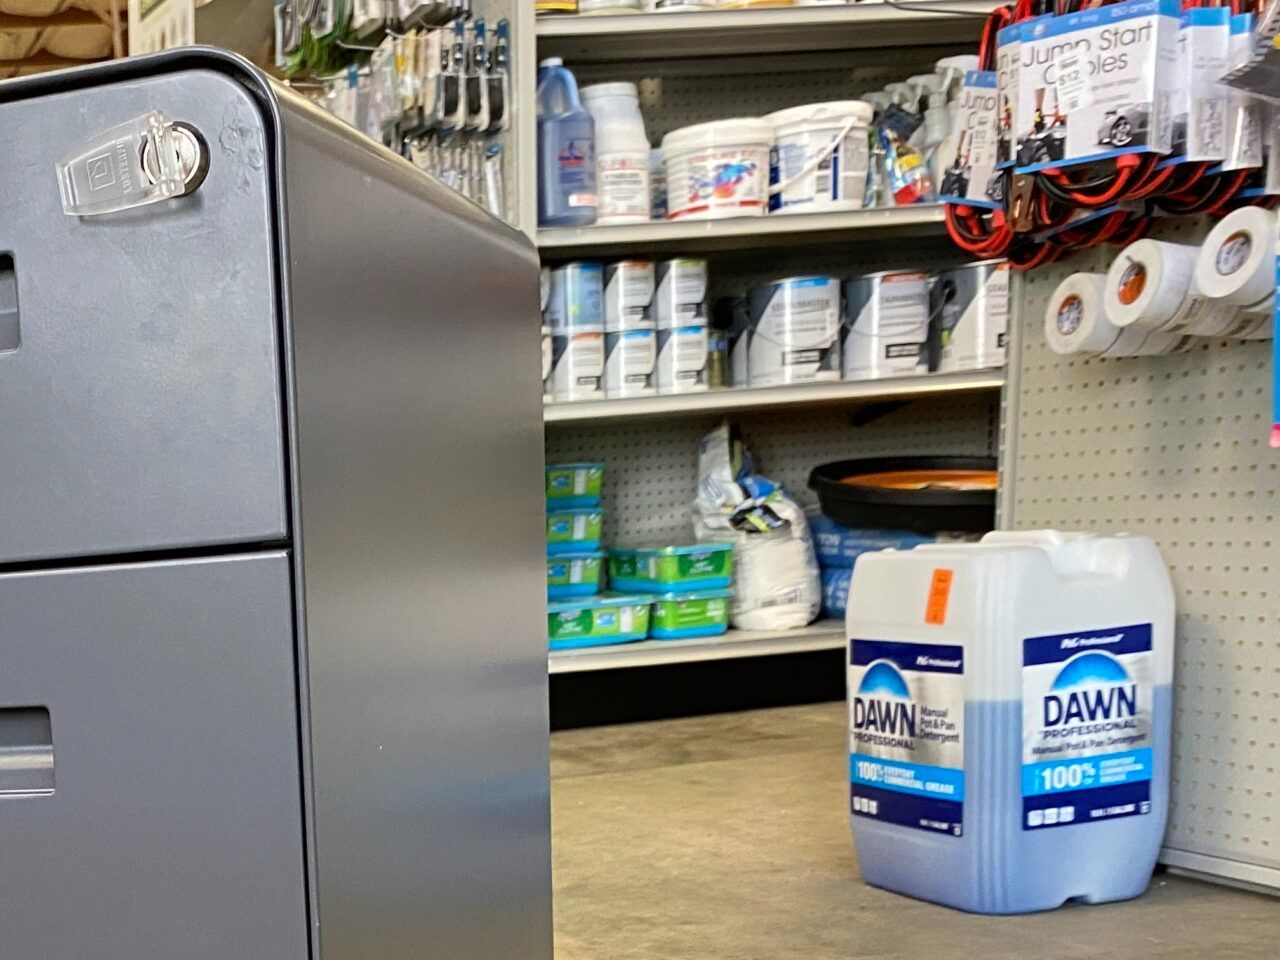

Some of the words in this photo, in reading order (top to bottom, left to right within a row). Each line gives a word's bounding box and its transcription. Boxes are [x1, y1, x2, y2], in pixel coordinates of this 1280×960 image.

[1099, 21, 1154, 51] Start
[1044, 52, 1128, 85] Cles
[854, 697, 916, 738] DAWN
[920, 705, 948, 718] Manual
[1044, 684, 1136, 728] DAWN
[854, 731, 916, 751] PROFESSIONAL
[1042, 719, 1137, 740] PROFESSIONAL
[1040, 761, 1096, 790] 100%
